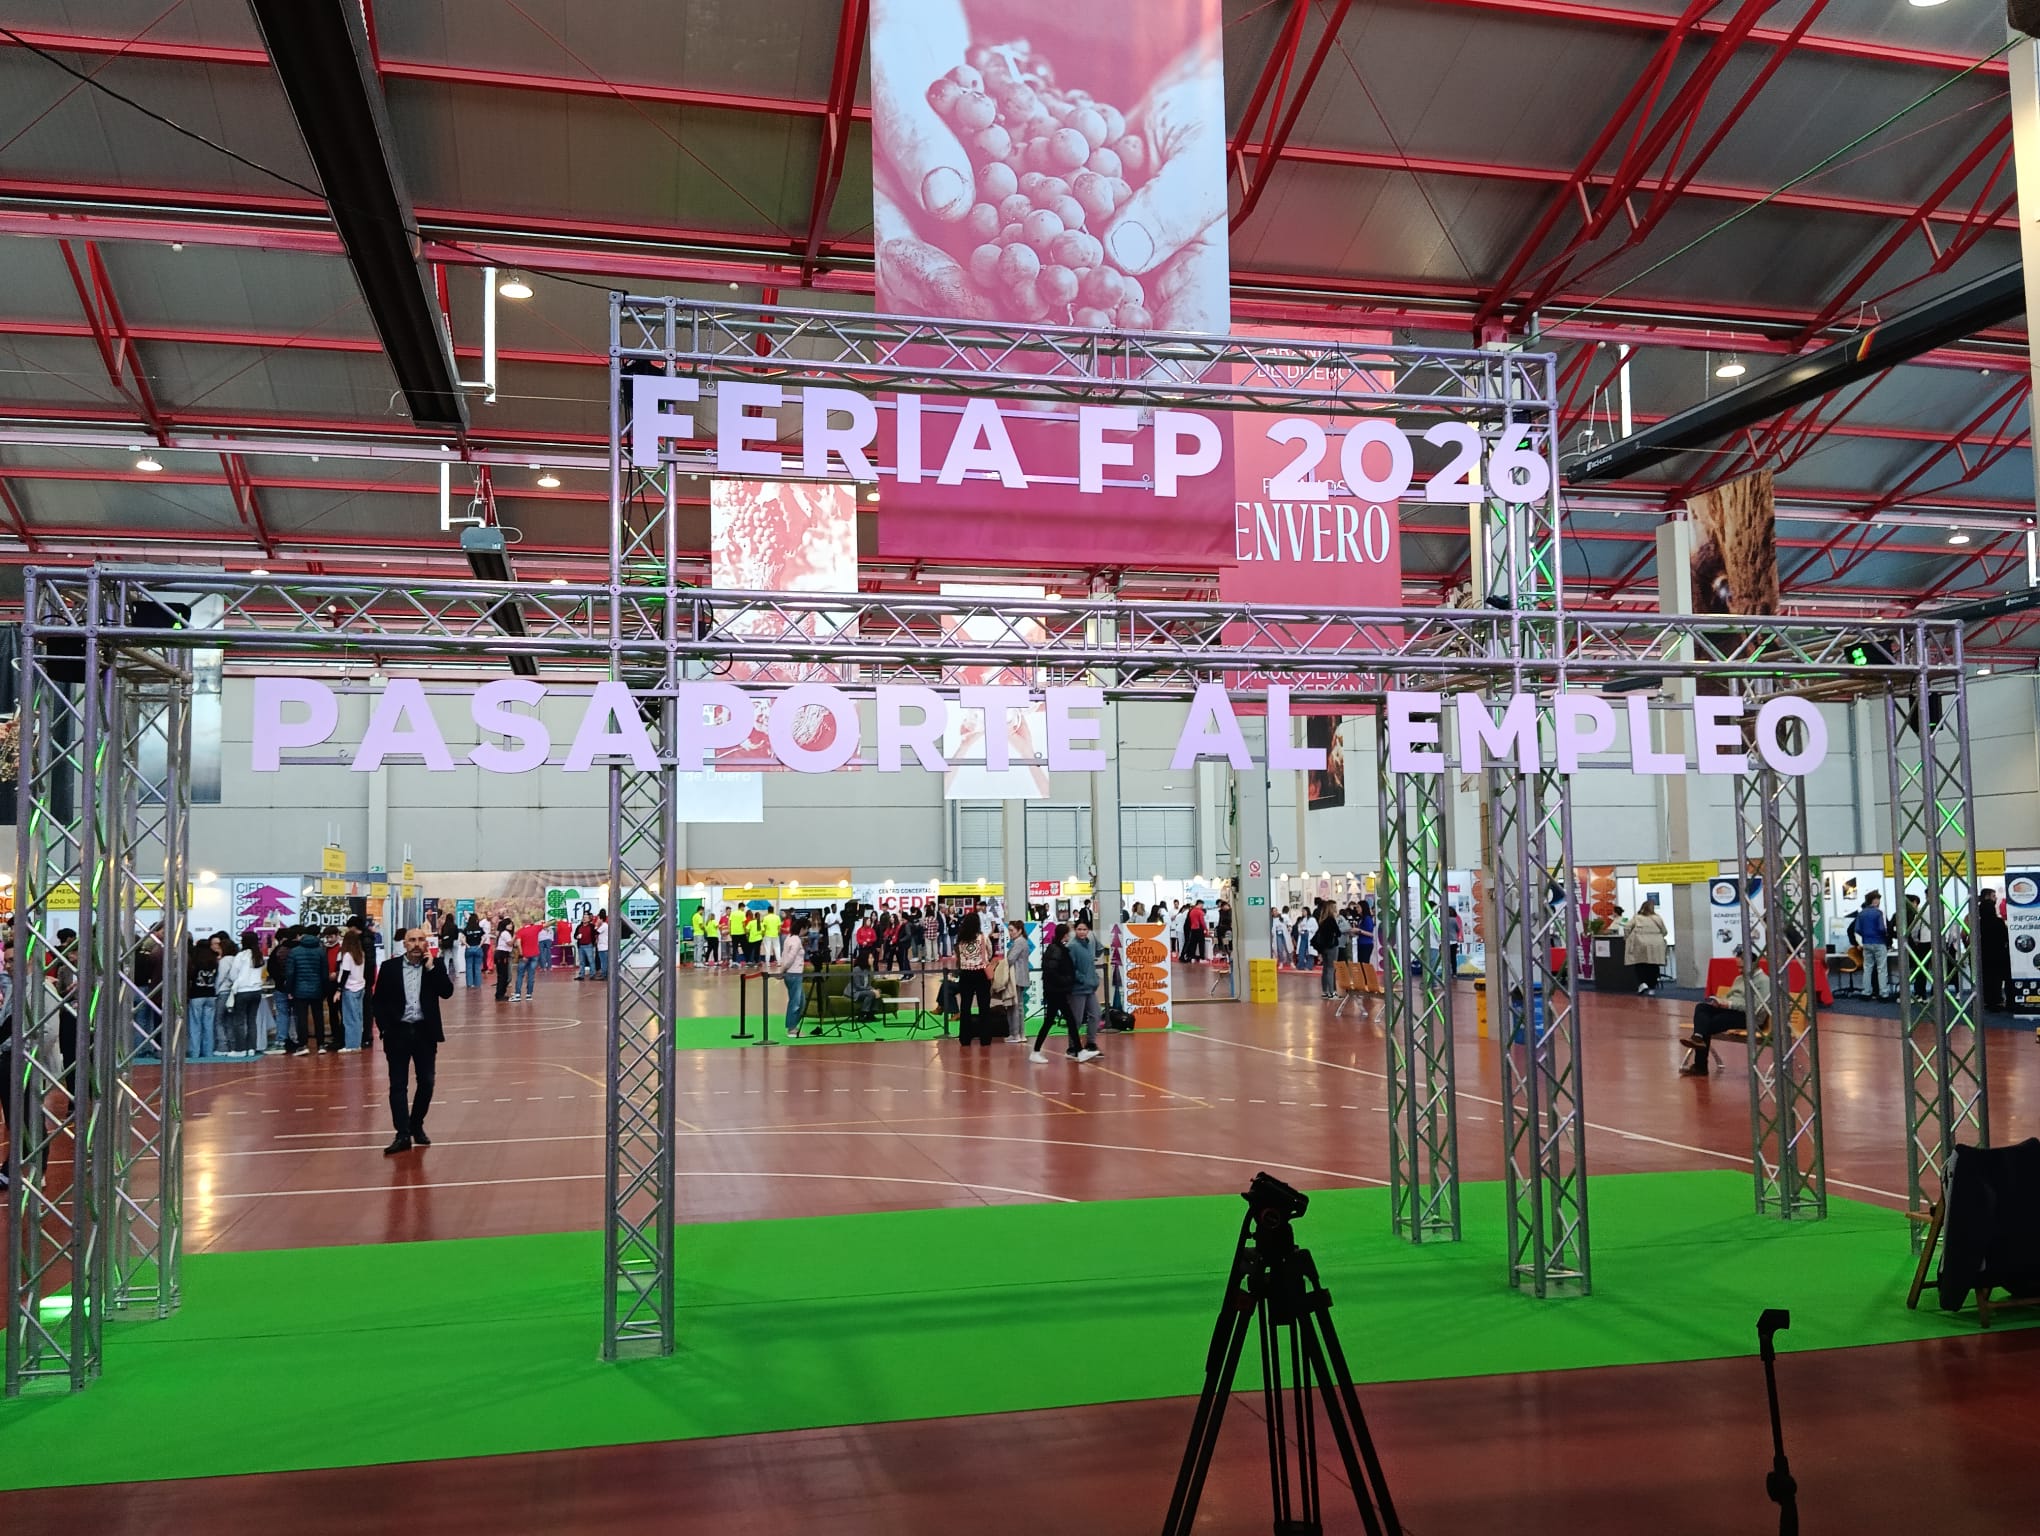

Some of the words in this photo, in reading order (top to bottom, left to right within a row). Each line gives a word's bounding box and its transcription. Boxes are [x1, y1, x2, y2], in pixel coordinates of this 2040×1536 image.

[632, 375, 1029, 489] FERIA
[1079, 406, 1223, 497] FP
[1266, 418, 1551, 503] 2026
[1235, 502, 1391, 563] ENVERO
[251, 677, 1107, 774] PASAPORTE
[1173, 684, 1328, 770] AL
[1387, 691, 1828, 776] EMPLEO
[1785, 883, 1819, 898] EXO
[1126, 946, 1154, 955] SANTA
[1126, 956, 1167, 964] CATALINA
[1127, 972, 1154, 980] SANTA
[1127, 981, 1167, 989] CATALINA
[1127, 998, 1155, 1006] SANTA
[1127, 1006, 1167, 1015] CATALINA
